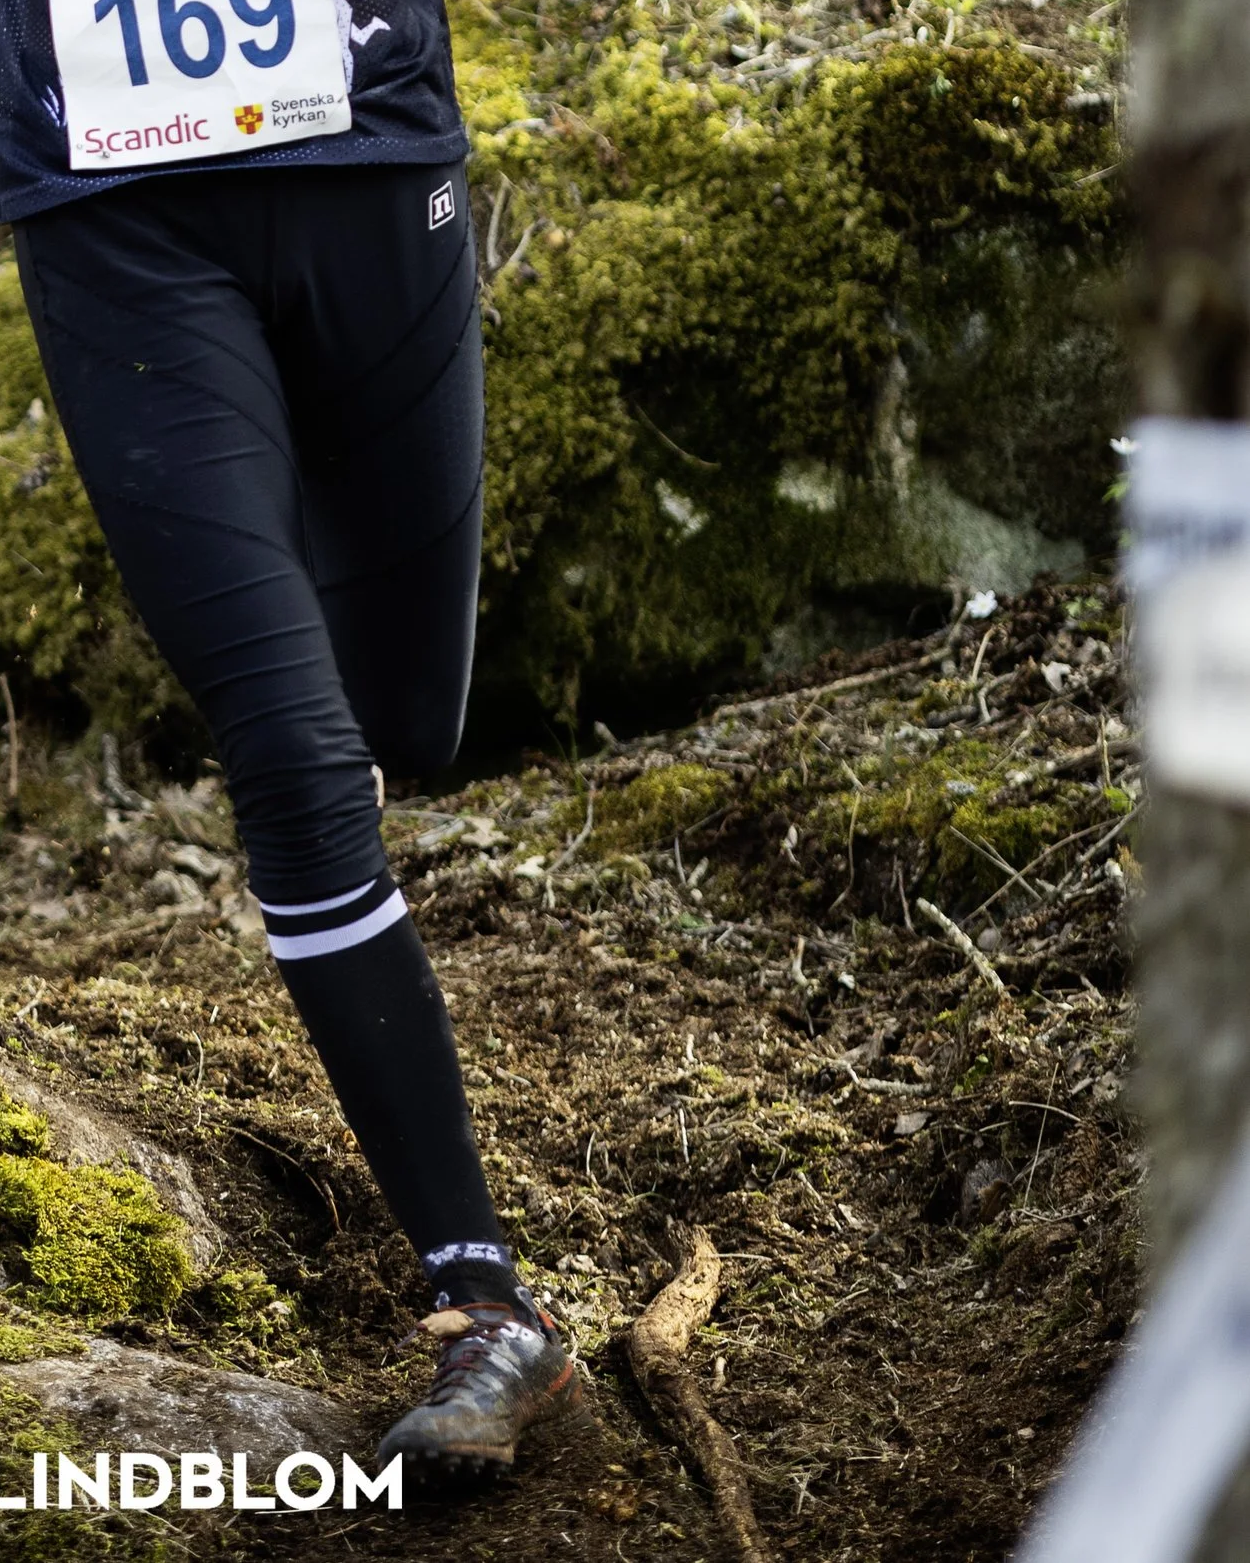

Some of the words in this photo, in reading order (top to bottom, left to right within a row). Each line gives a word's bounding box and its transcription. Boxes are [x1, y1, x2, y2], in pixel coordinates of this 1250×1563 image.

[271, 93, 335, 113] Svenska
[272, 109, 327, 129] kyrkan
[84, 113, 211, 154] Scandic
